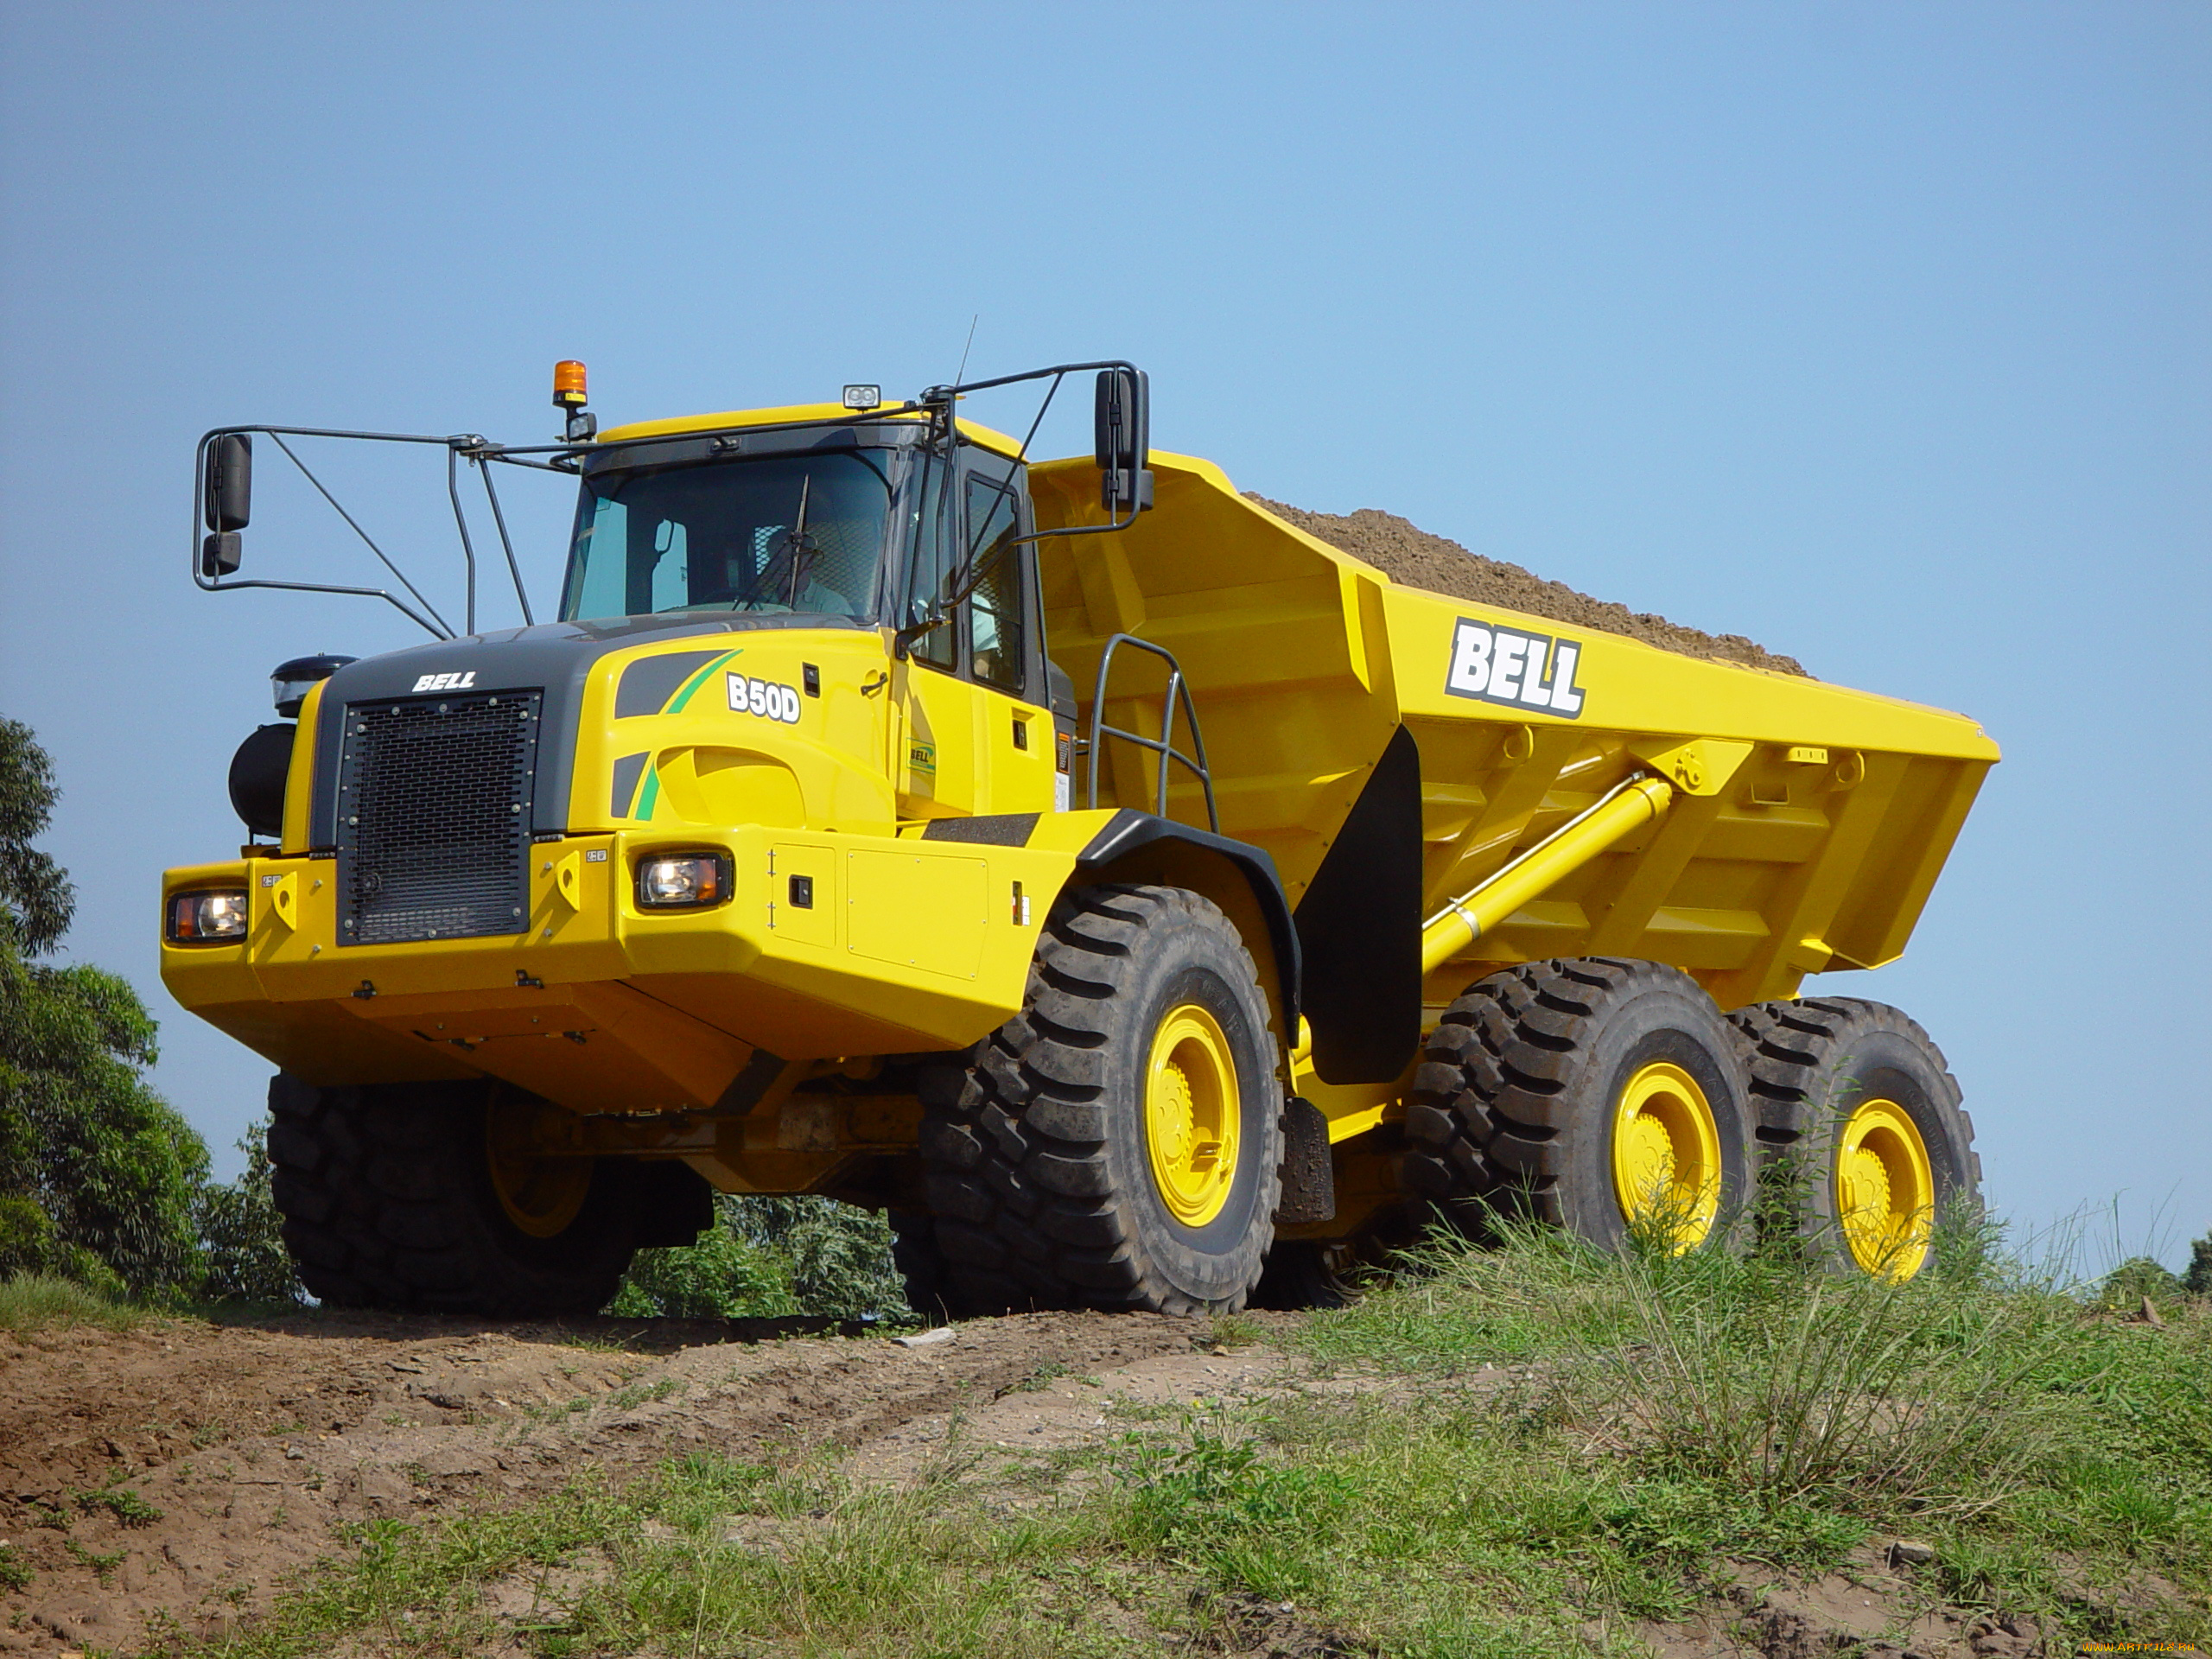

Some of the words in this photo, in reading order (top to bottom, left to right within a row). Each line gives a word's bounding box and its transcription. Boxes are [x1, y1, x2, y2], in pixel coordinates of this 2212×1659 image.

[411, 671, 476, 693] BELL
[1446, 618, 1586, 719] BELL
[727, 671, 801, 725] B50D
[911, 749, 929, 762] BELL
